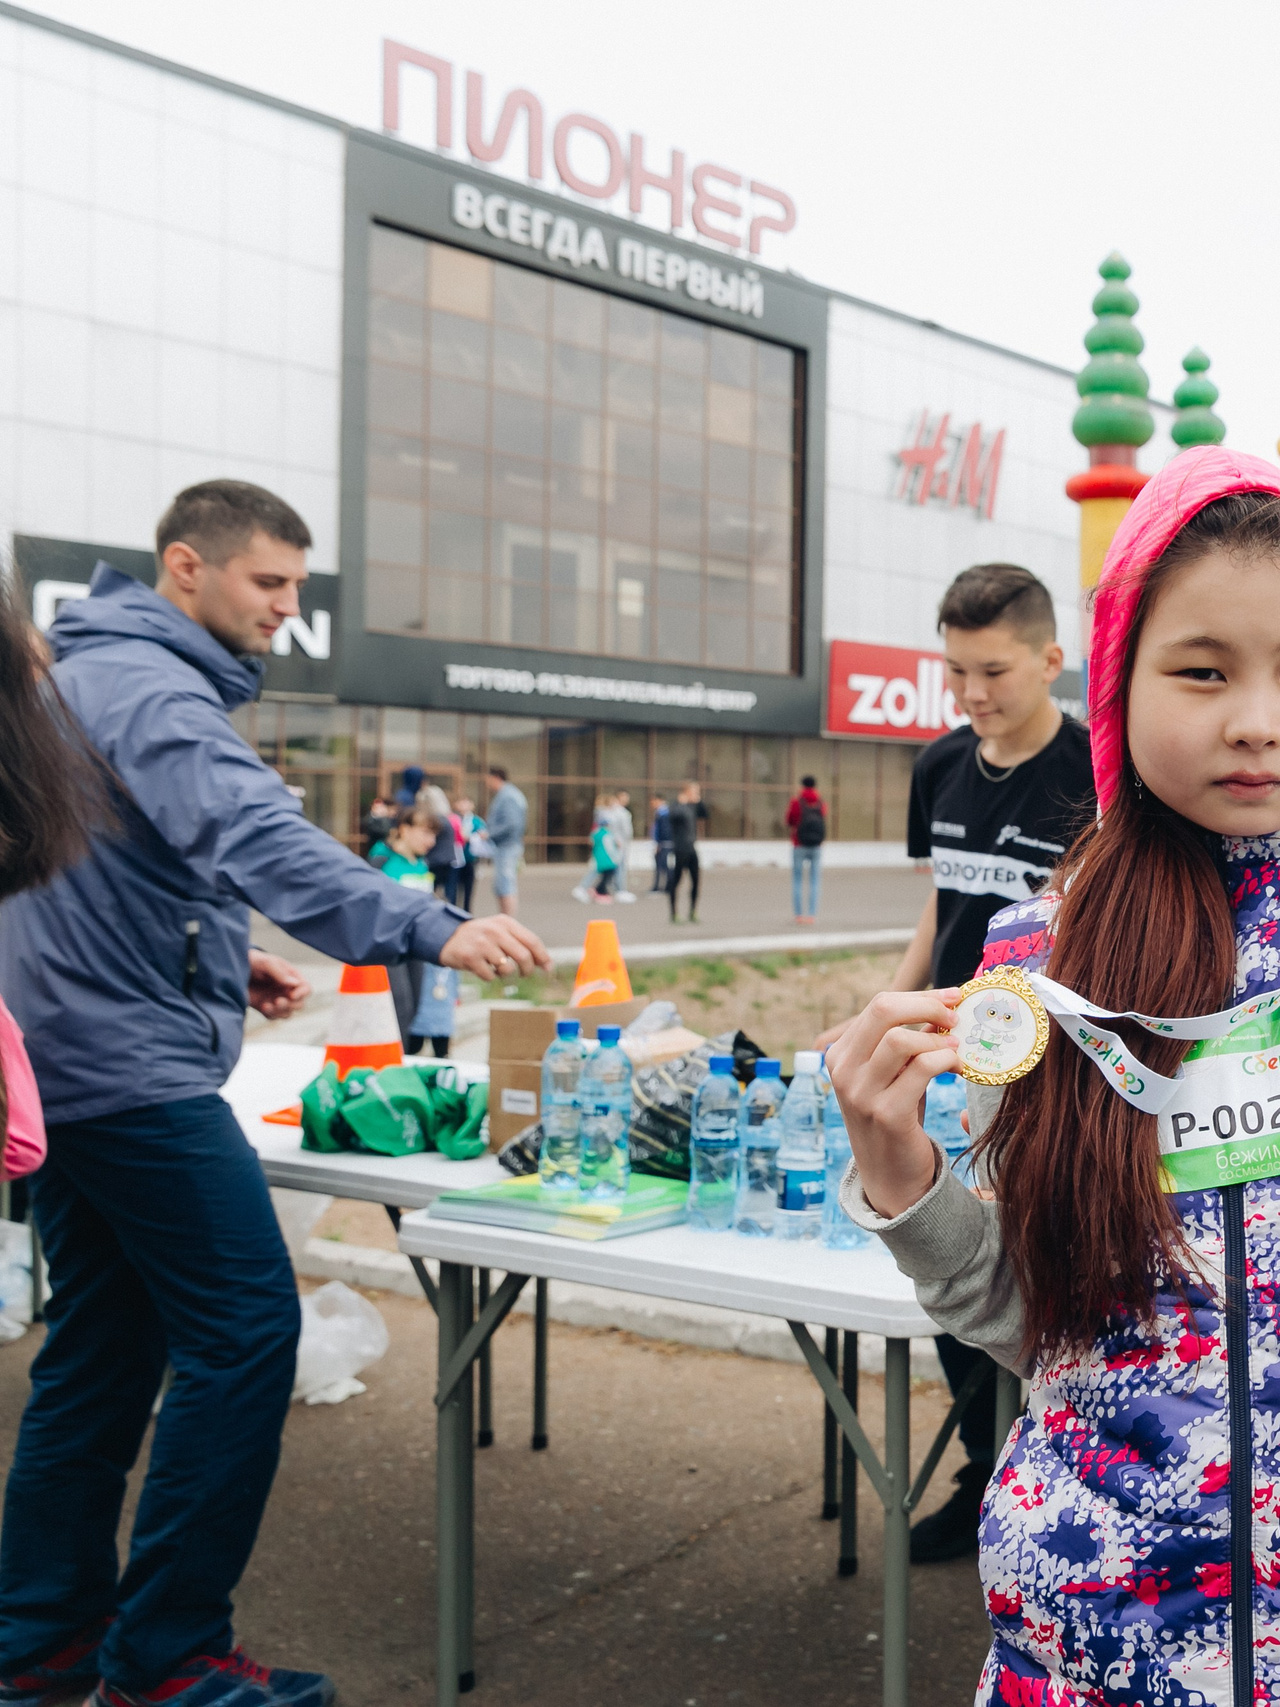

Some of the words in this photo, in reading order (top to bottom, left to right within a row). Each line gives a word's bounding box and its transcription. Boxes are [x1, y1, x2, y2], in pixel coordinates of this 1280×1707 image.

[382, 38, 797, 255] ПИОНЕР
[452, 183, 611, 271] ВСЕГДА
[618, 237, 765, 319] ПЕРВЫЙ
[896, 408, 1005, 522] H&M
